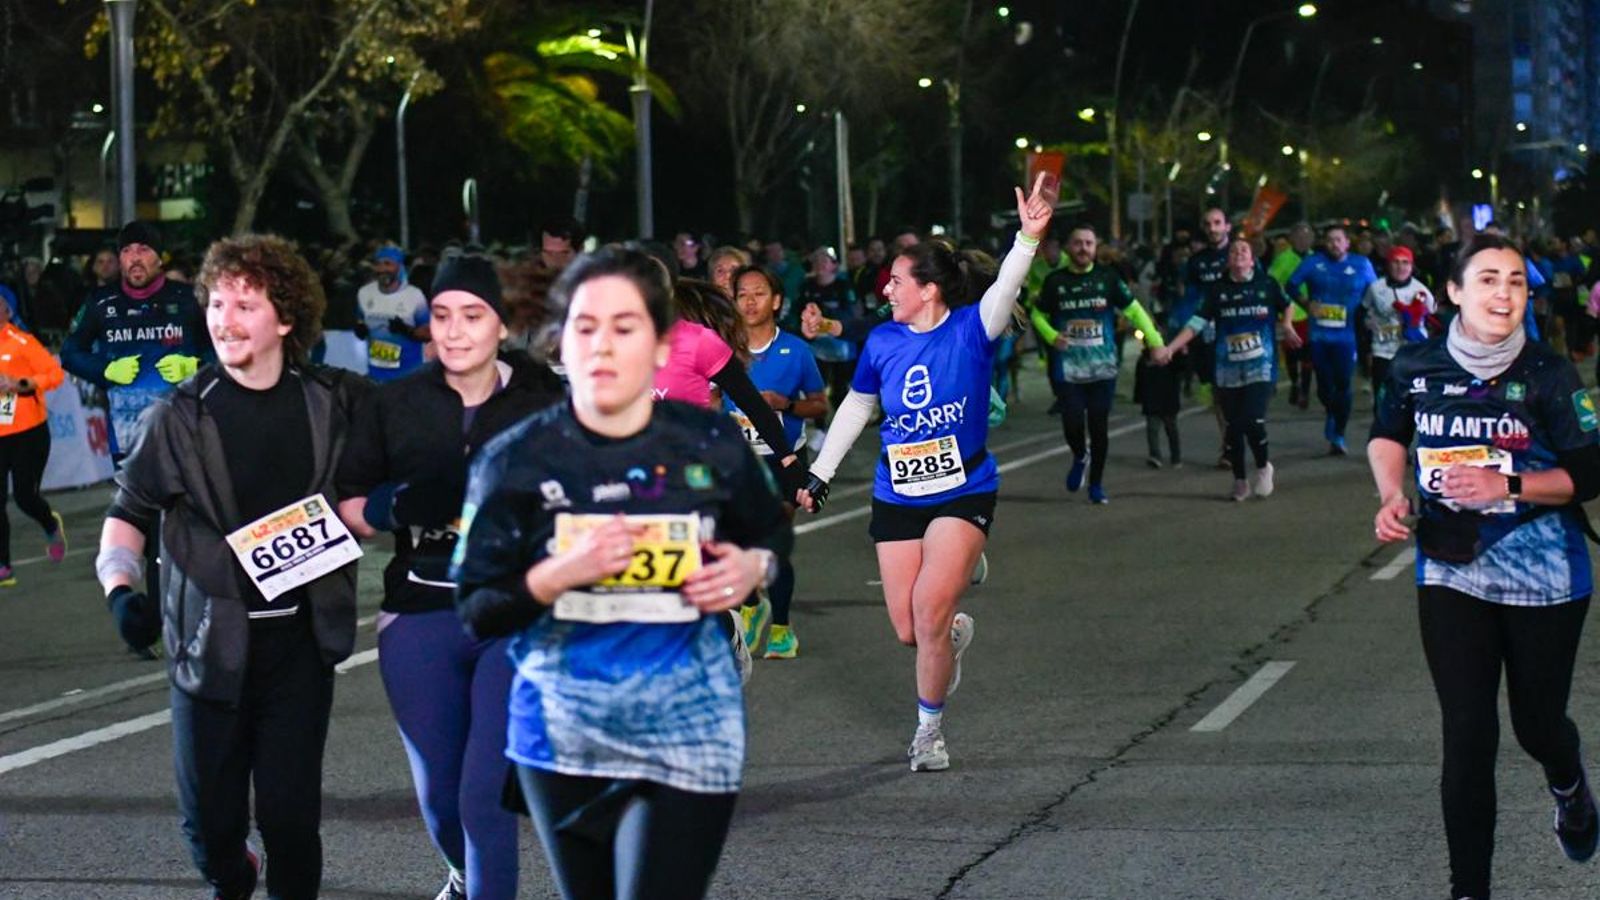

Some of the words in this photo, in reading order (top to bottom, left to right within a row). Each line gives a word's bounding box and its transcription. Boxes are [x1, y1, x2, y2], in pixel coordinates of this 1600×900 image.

[106, 327, 132, 342] SAN
[136, 322, 183, 341] ANTÓN
[1414, 410, 1444, 436] SAN
[1449, 412, 1529, 438] ANTÓN
[895, 451, 955, 477] 9285
[251, 517, 329, 569] 6687
